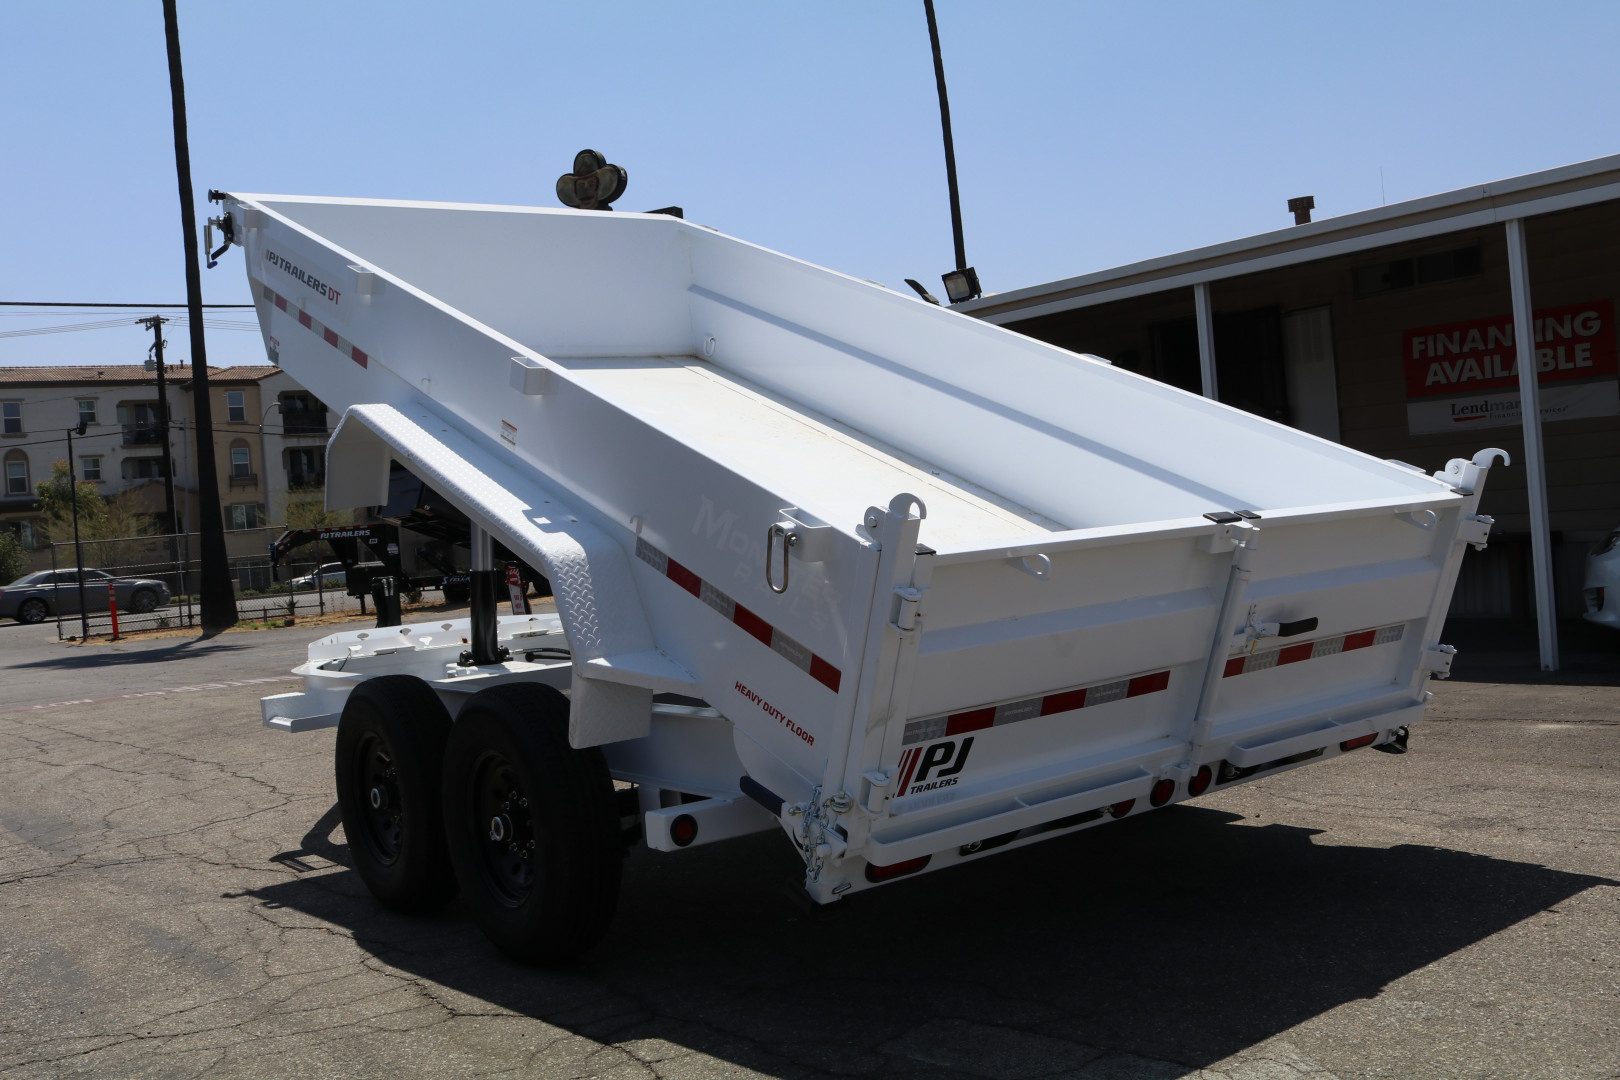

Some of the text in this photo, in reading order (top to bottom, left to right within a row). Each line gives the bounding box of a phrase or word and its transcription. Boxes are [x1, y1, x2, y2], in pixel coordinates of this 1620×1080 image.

[327, 286, 342, 305] DT
[1412, 310, 1601, 360] FINANING
[1451, 400, 1522, 416] Lendmar
[734, 680, 815, 747] HEAVY DUTY FLOOR
[914, 736, 975, 783] PJ
[910, 776, 959, 795] TRAILERS
